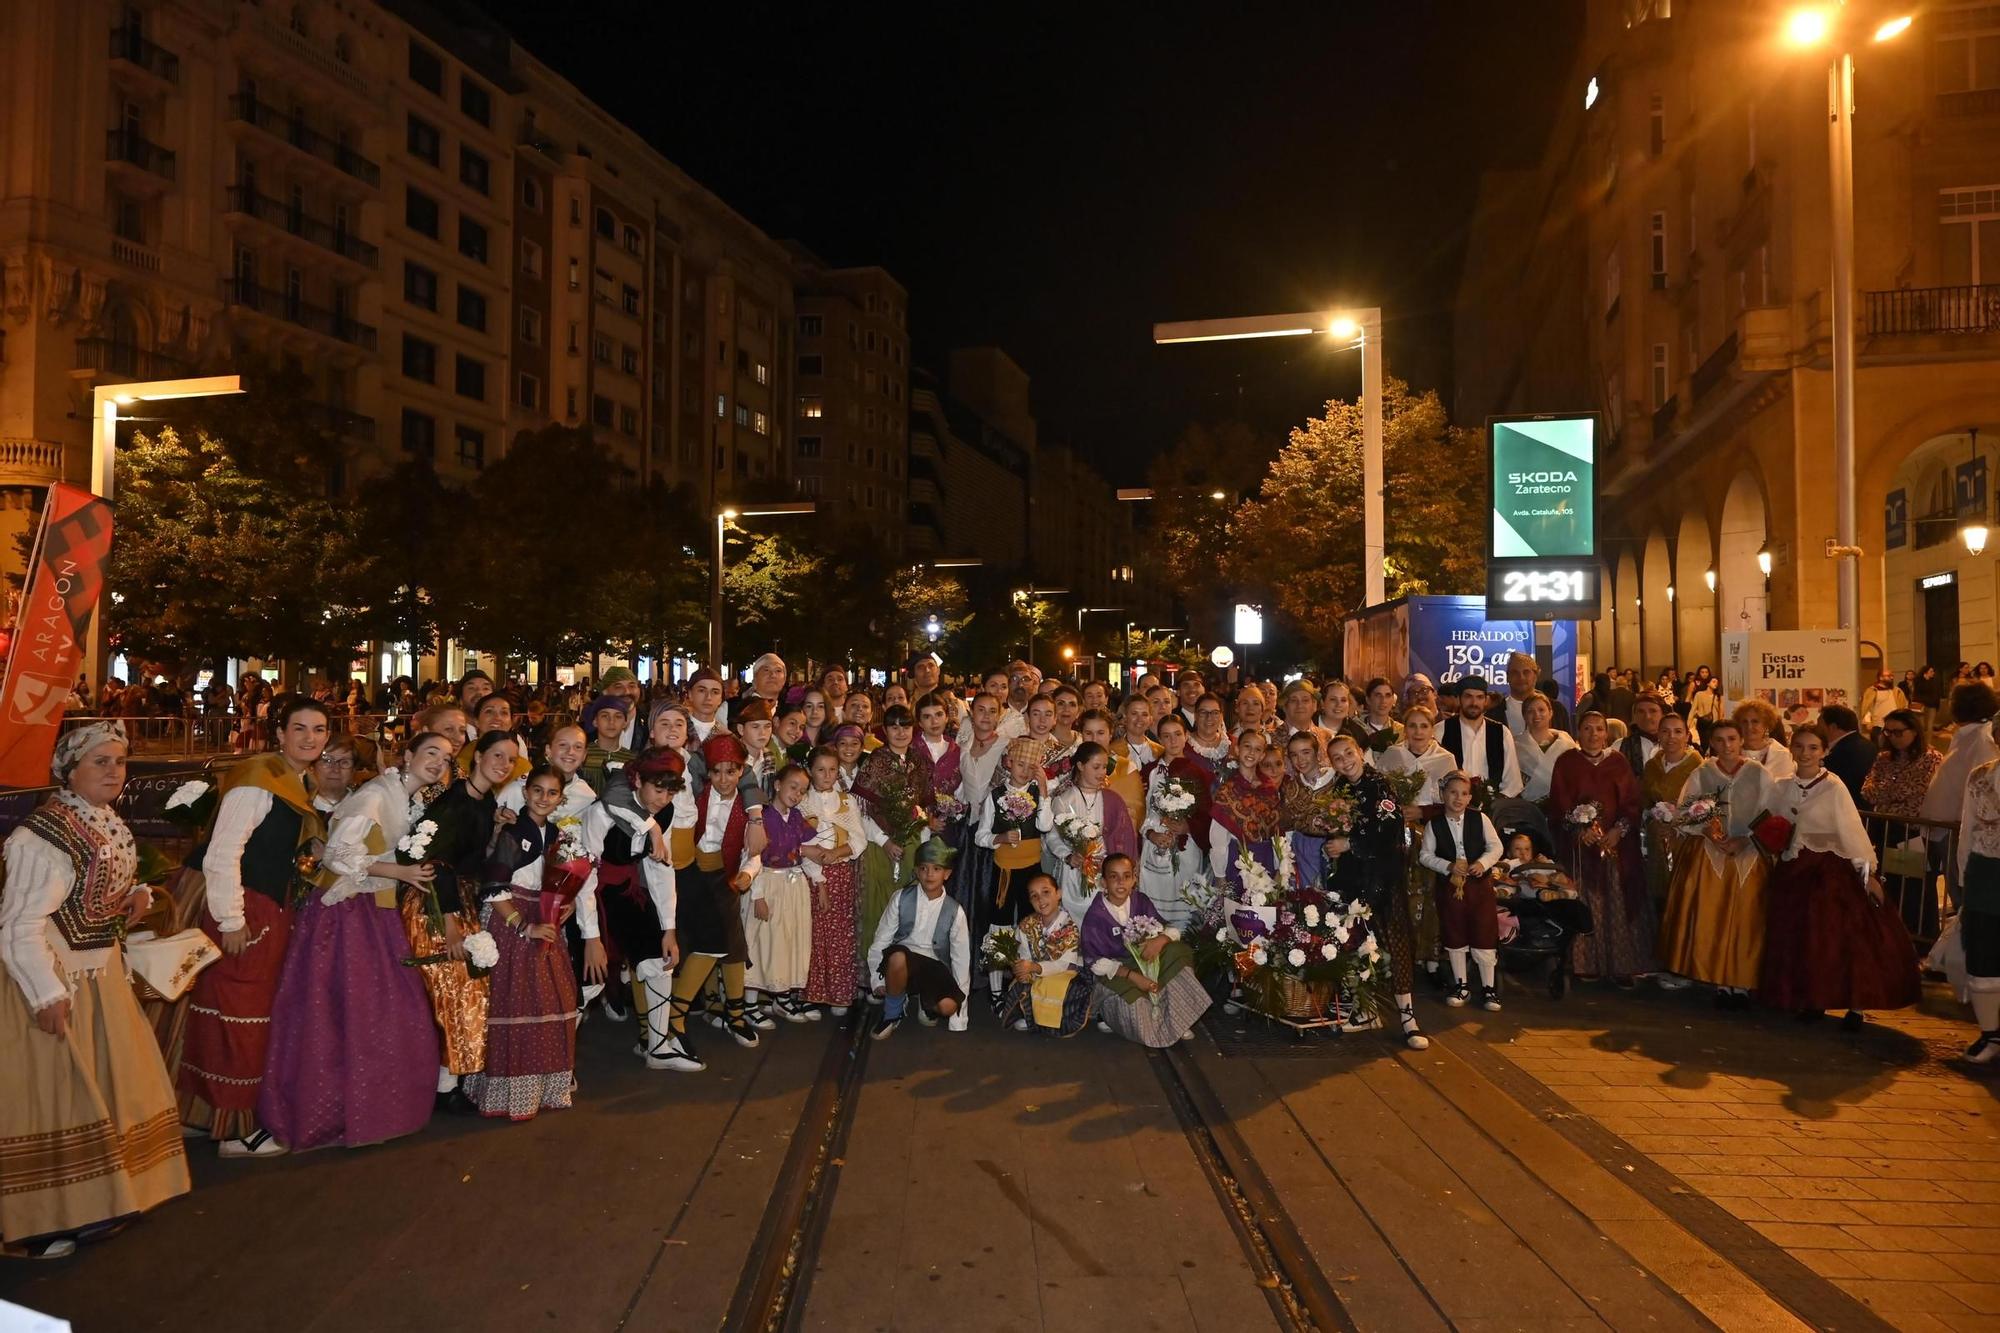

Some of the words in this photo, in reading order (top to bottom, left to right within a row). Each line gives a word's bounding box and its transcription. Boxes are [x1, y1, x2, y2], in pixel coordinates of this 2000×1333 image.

[1515, 484, 1571, 494] Zaratecno
[1504, 570, 1583, 602] 21:31
[32, 560, 77, 662] ARAGÓN
[1452, 631, 1513, 642] HERALDO
[55, 635, 73, 664] TV
[1445, 644, 1484, 665] 130
[1762, 653, 1805, 663] Fiestas
[1440, 664, 1462, 684] de
[1470, 664, 1510, 685] Pila
[1762, 664, 1805, 679] Pilar
